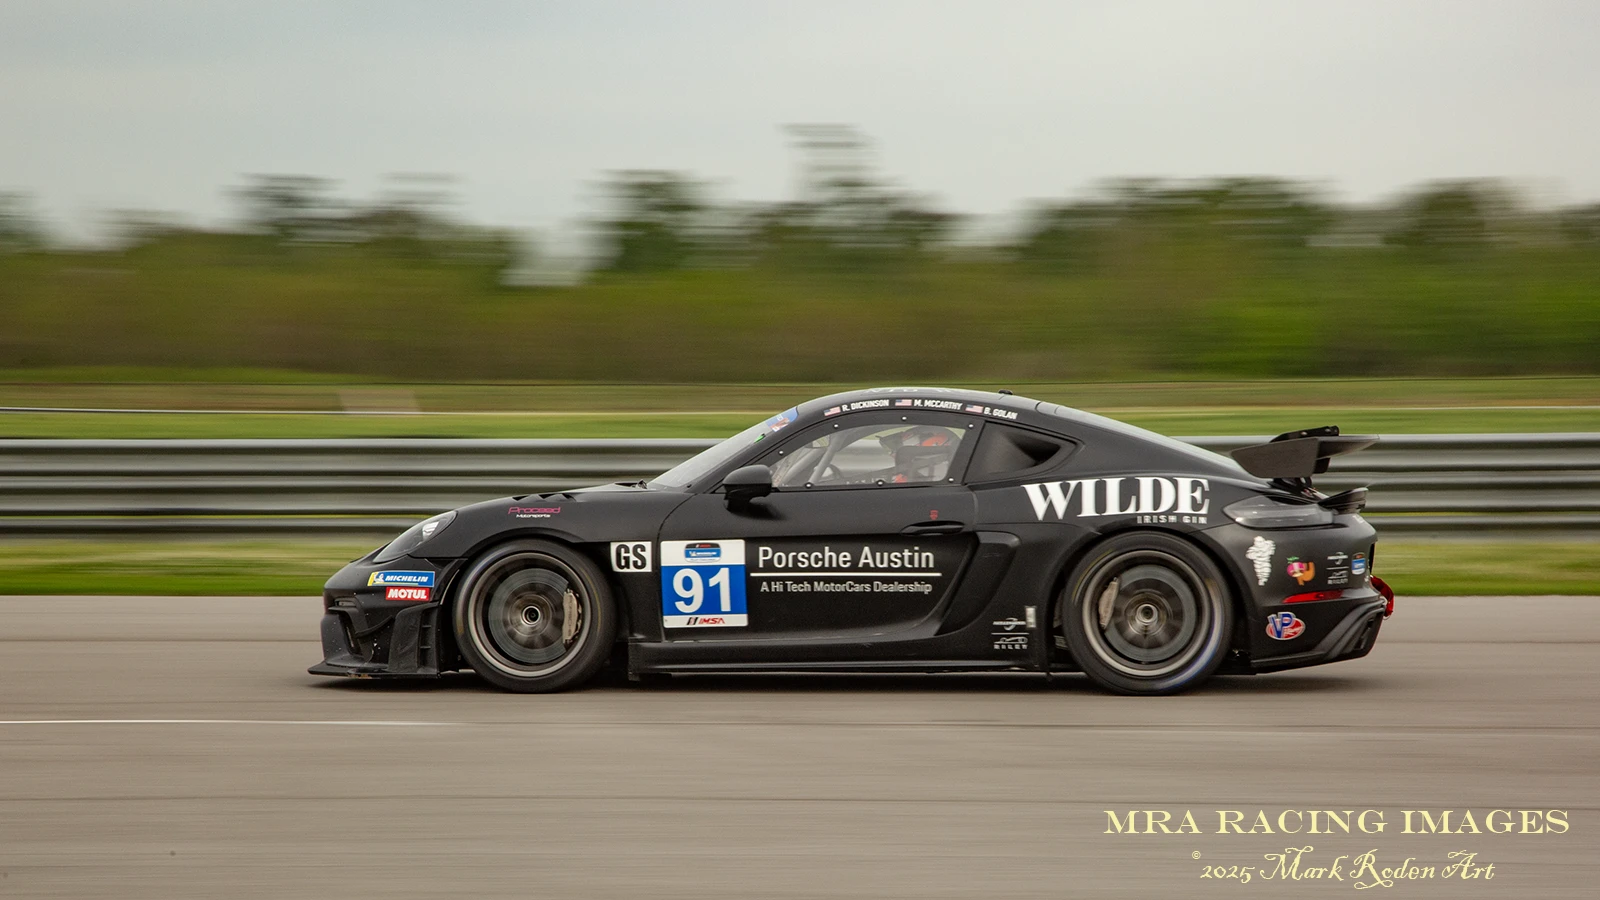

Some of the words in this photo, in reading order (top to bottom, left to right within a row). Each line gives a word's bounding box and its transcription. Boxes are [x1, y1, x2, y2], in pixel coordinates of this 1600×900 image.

[851, 399, 890, 411] DICKINSON
[914, 399, 923, 408] M.
[924, 399, 963, 411] MCCARTHY
[993, 408, 1018, 420] GOLAN
[1021, 476, 1211, 521] WILDE
[1136, 515, 1178, 524] IRISH
[1182, 515, 1208, 524] GIN
[615, 543, 647, 570] GS
[758, 545, 852, 568] Porsche
[857, 545, 935, 568] Austin
[385, 575, 429, 583] MICHELIN
[387, 588, 428, 600] MOTUL
[672, 567, 732, 614] 91
[760, 581, 770, 592] A
[771, 581, 784, 592] Hi
[785, 581, 812, 592] Tech
[813, 581, 872, 592] MotorCars
[873, 581, 933, 595] Dealership
